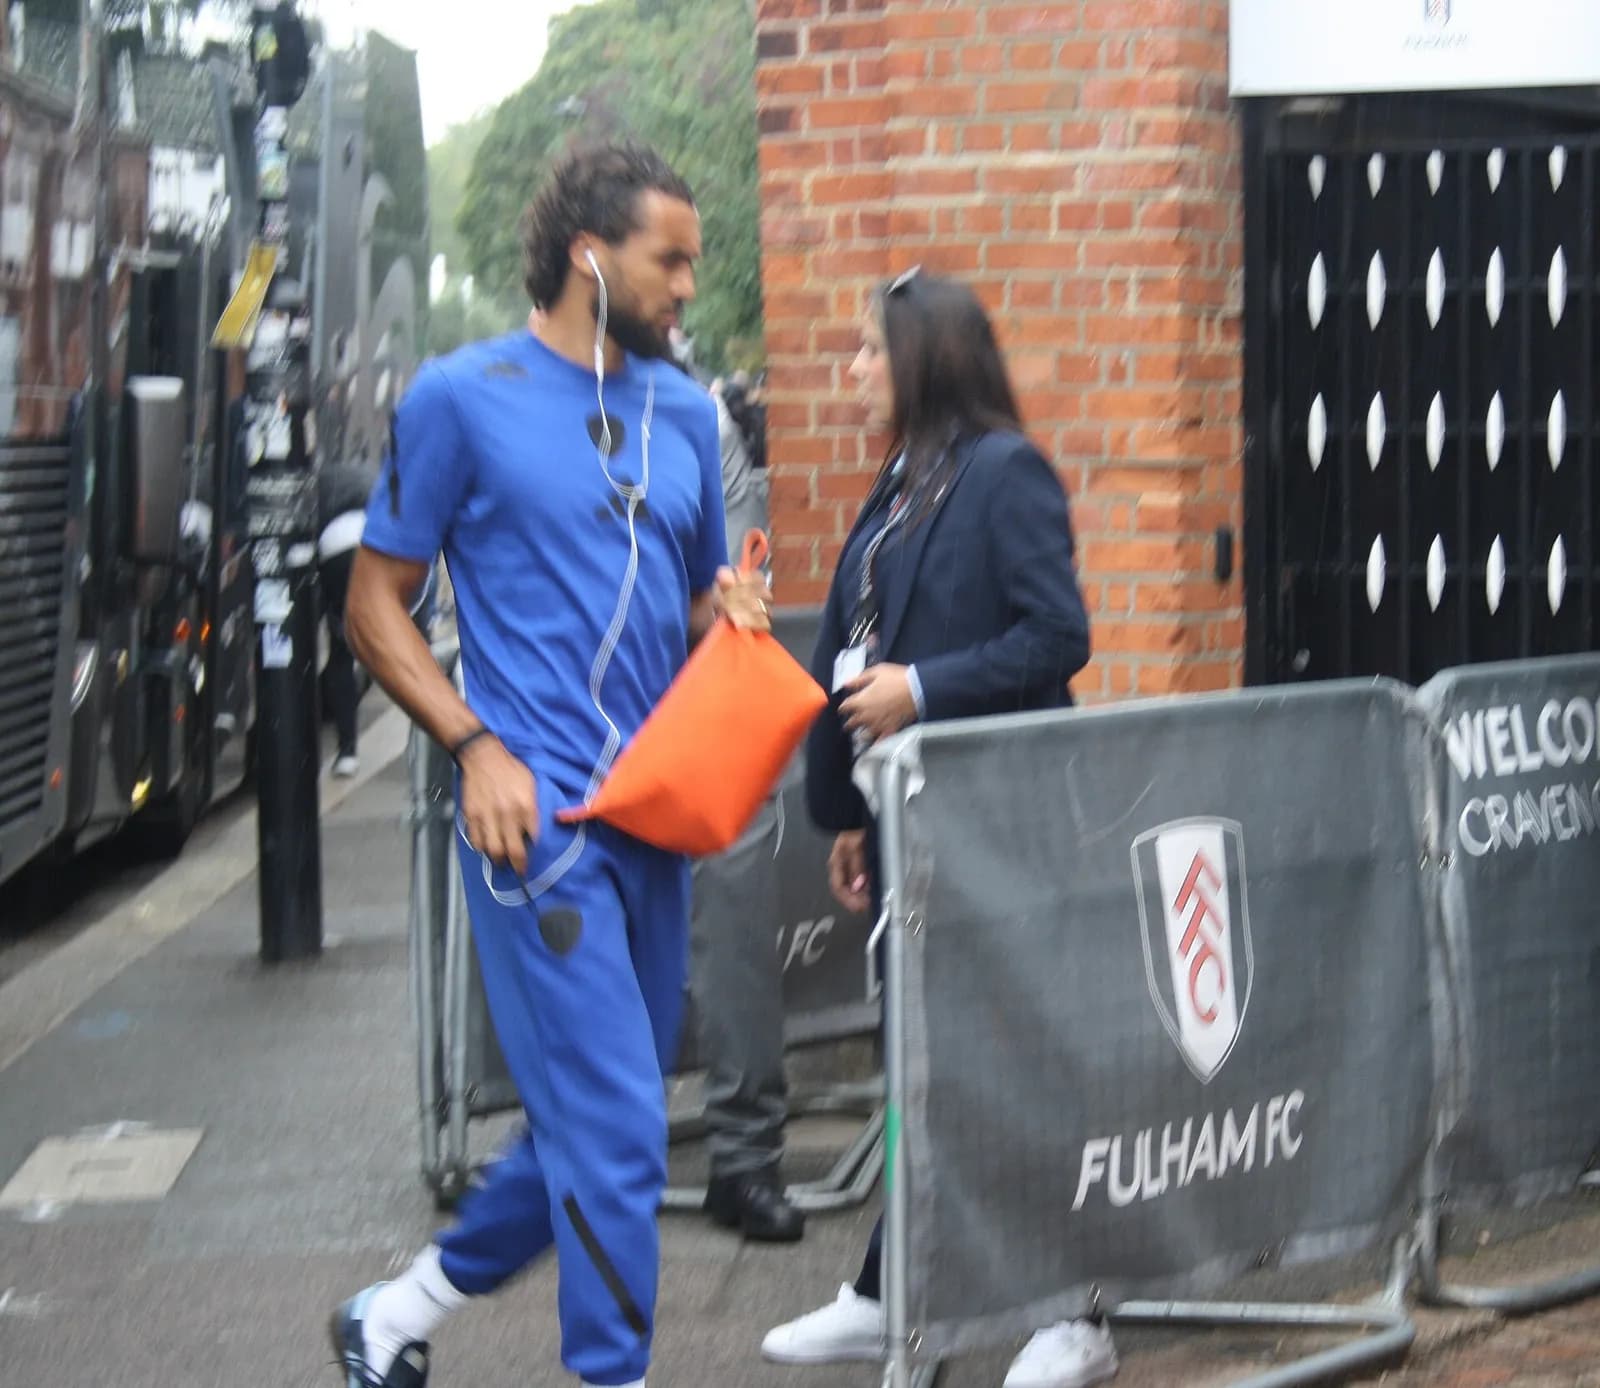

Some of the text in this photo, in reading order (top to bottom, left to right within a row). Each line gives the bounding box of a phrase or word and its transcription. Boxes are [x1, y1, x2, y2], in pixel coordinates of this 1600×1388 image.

[1441, 696, 1600, 782] WELCO
[1458, 780, 1594, 857] CRAVEN
[781, 914, 836, 976] FC
[1173, 850, 1225, 1025] FFC
[1069, 1088, 1304, 1212] FULHAM FC
